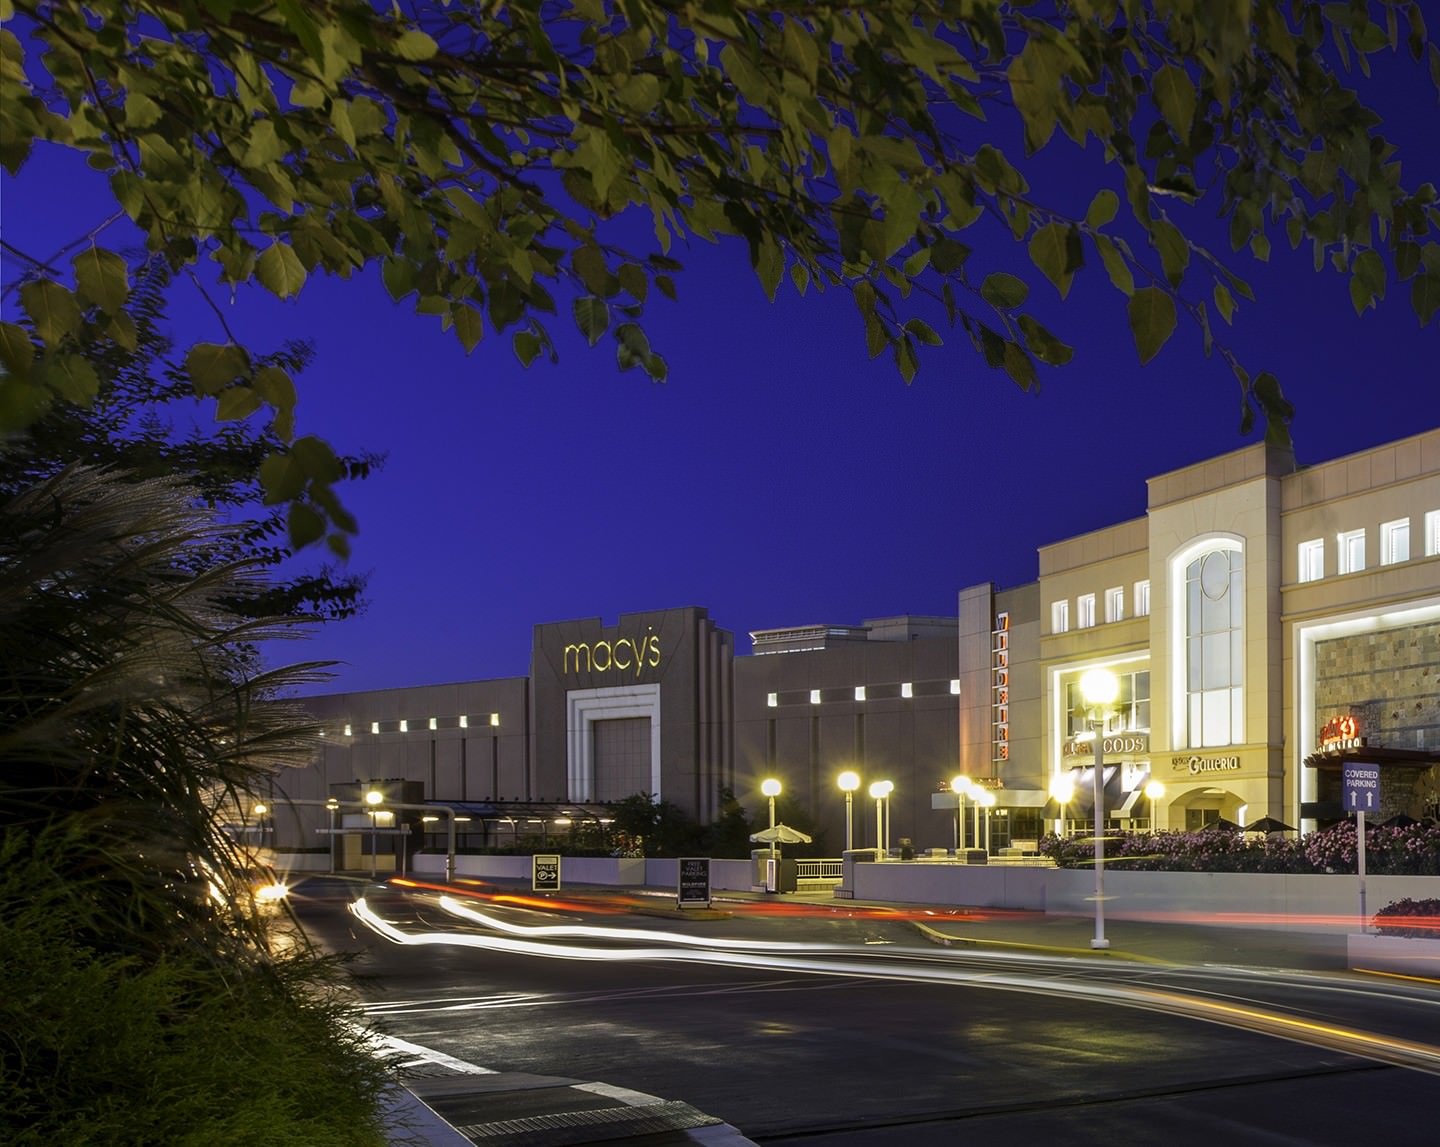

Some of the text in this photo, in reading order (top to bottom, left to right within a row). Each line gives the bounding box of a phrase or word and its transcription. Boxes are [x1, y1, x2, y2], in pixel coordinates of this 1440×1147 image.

[564, 626, 661, 677] macy's
[1344, 769, 1378, 779] COVERED
[1346, 779, 1377, 788] PARKING
